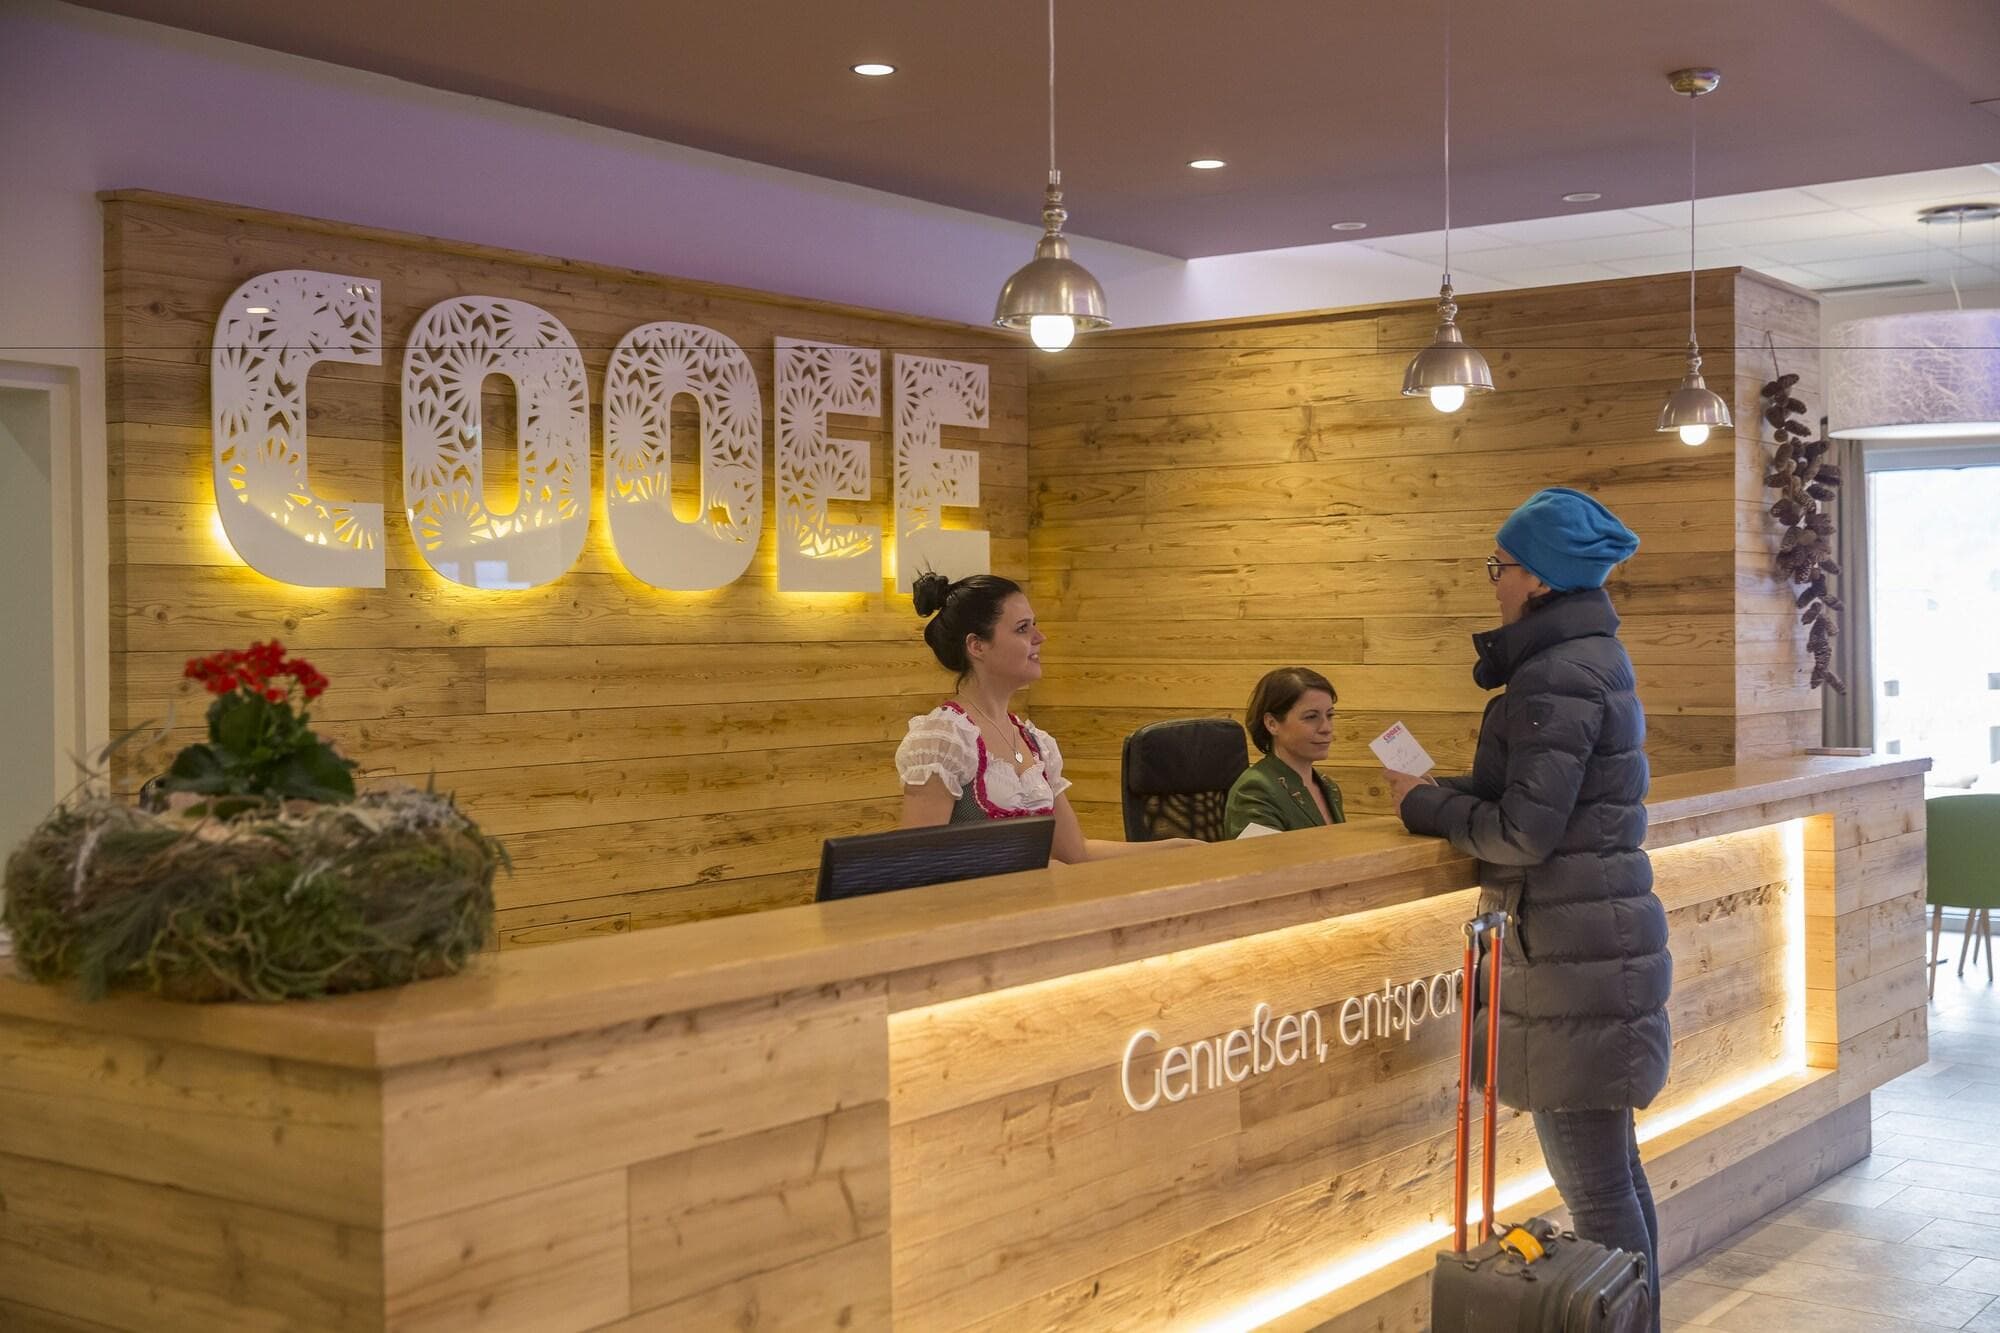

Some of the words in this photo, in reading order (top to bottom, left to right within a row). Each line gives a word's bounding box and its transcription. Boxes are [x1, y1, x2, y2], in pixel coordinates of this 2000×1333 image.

[211, 269, 990, 593] COOEE
[1121, 1002, 1328, 1112] Genießen,
[1339, 968, 1465, 1046] entspan
